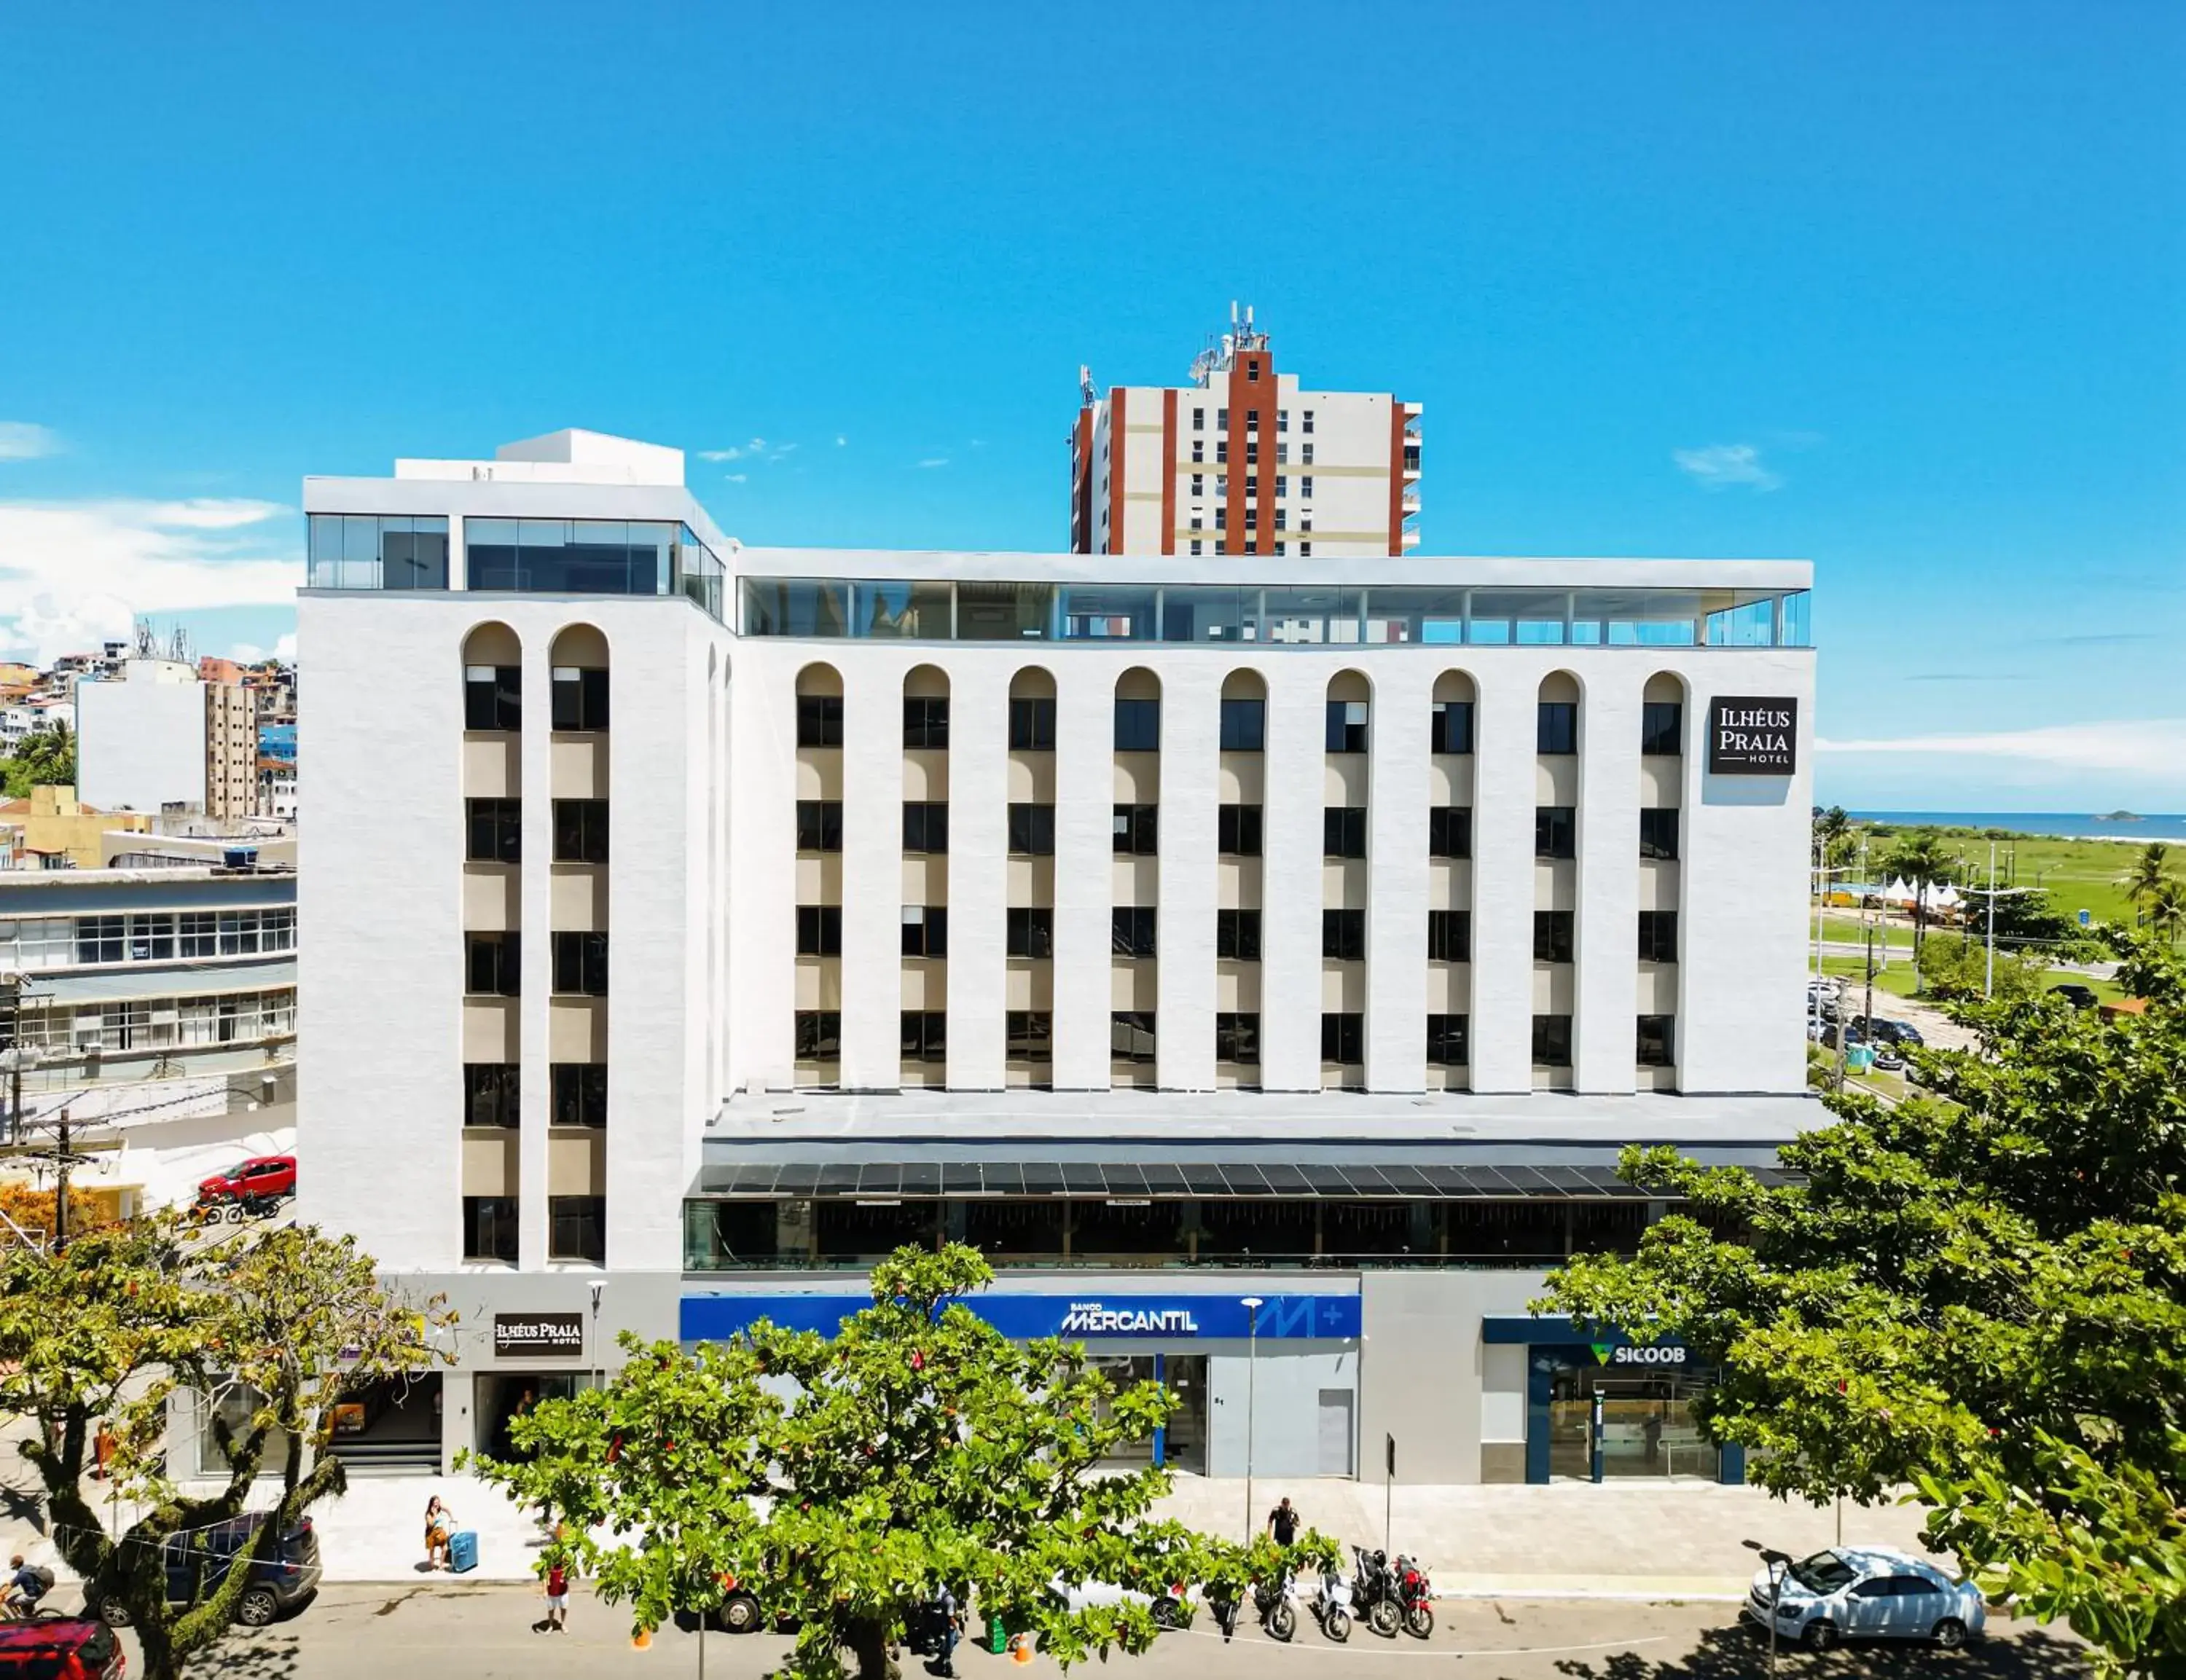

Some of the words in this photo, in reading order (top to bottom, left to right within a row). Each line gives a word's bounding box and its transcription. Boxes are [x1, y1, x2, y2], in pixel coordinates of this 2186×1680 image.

[1720, 707, 1790, 727] ILHÉUS
[1719, 730, 1789, 750] PRAIA
[1750, 754, 1789, 764] HOTEL
[496, 1322, 538, 1338] ILHÉUS
[539, 1322, 581, 1337] PRAIA
[1061, 1311, 1199, 1331] MERCANTIL
[1615, 1347, 1685, 1363] SICOOB
